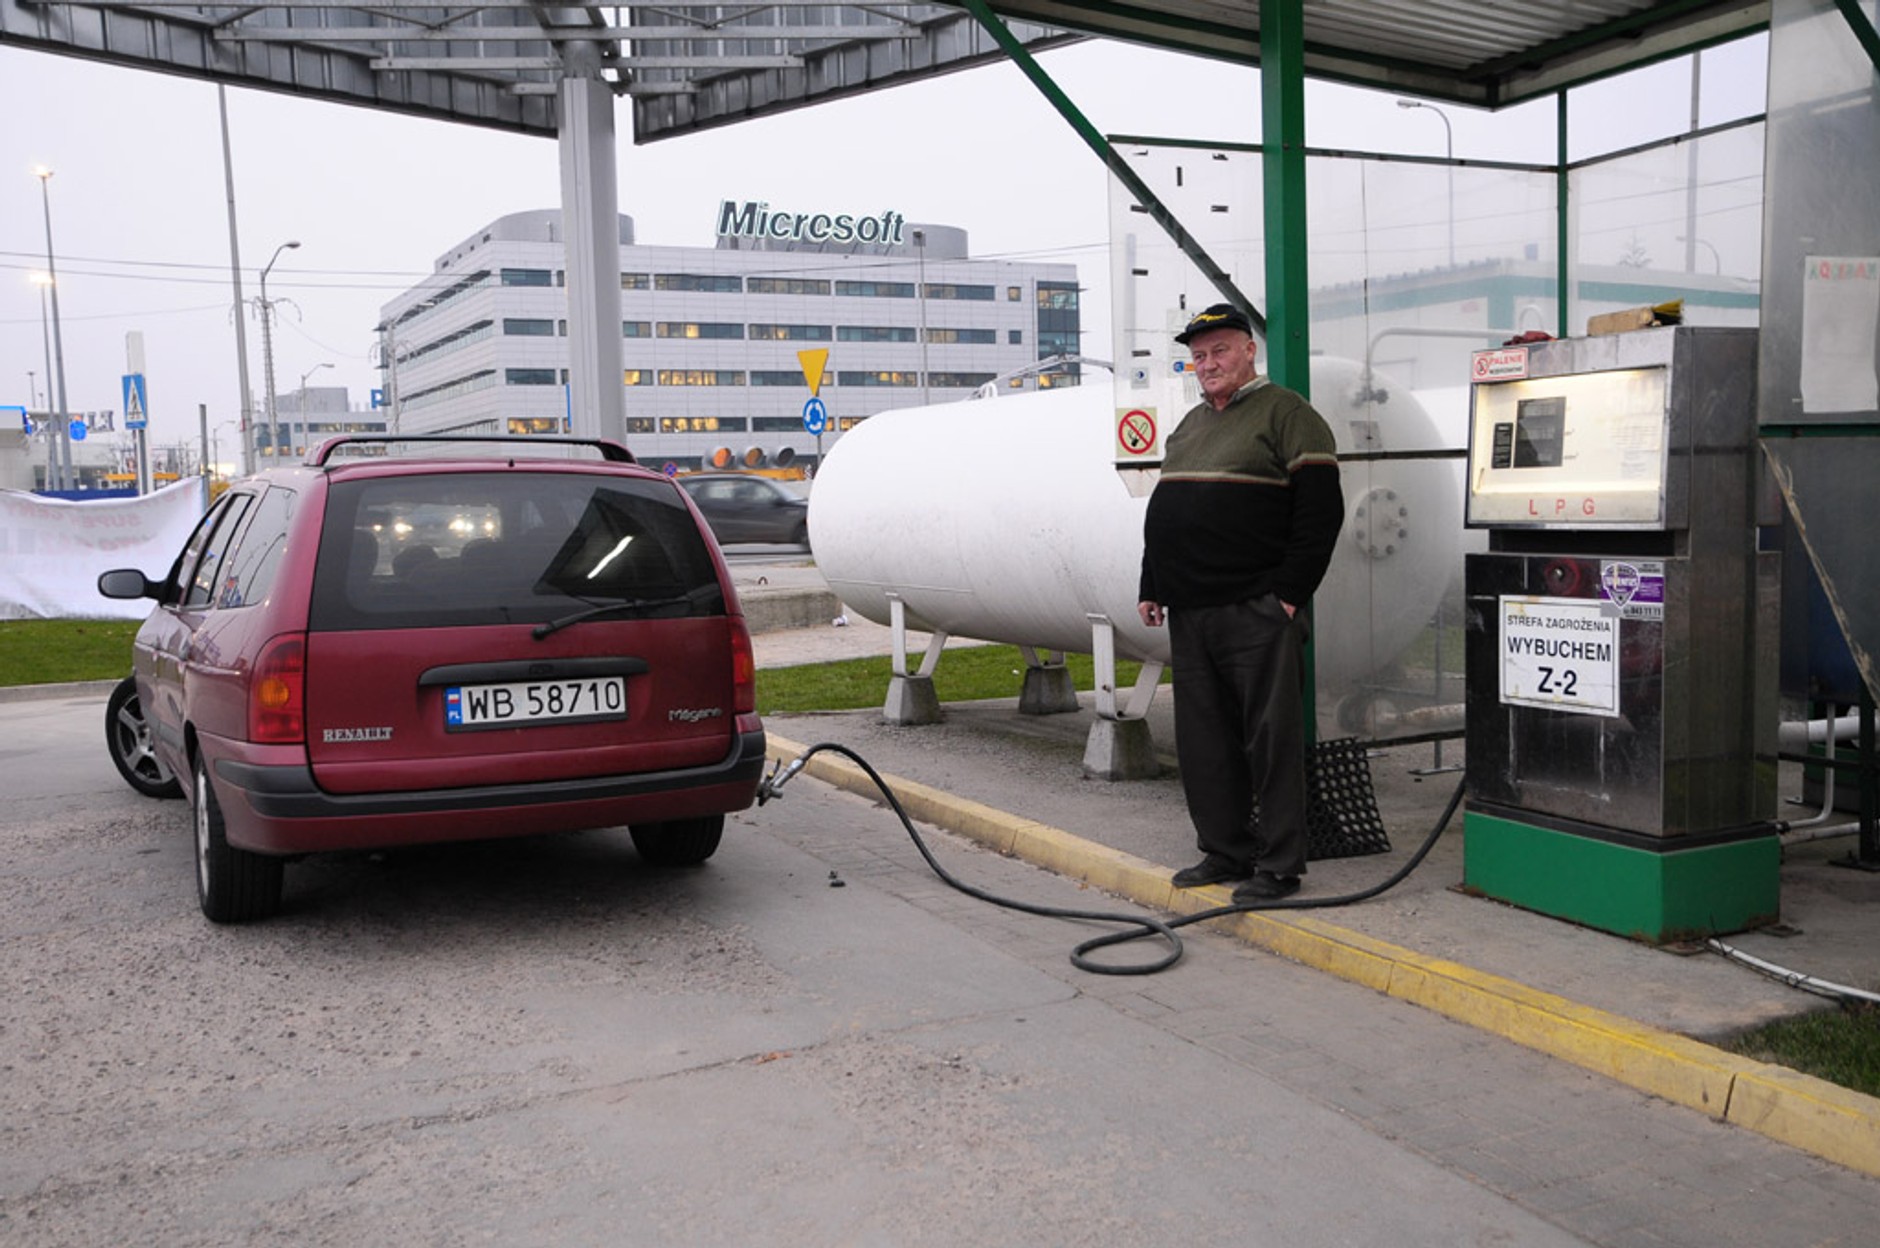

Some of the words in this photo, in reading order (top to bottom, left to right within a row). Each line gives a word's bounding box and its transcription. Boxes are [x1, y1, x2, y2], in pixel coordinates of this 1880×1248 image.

[718, 199, 905, 245] Microsoft
[1507, 614, 1543, 628] STREFA
[1546, 617, 1611, 632] ZAGROŻENIA
[1507, 636, 1612, 662] WYBUCHEM
[1537, 666, 1578, 697] Z-2
[467, 688, 515, 721] WB
[527, 680, 622, 716] 58710
[449, 711, 460, 720] PL
[322, 726, 394, 743] RENAULT
